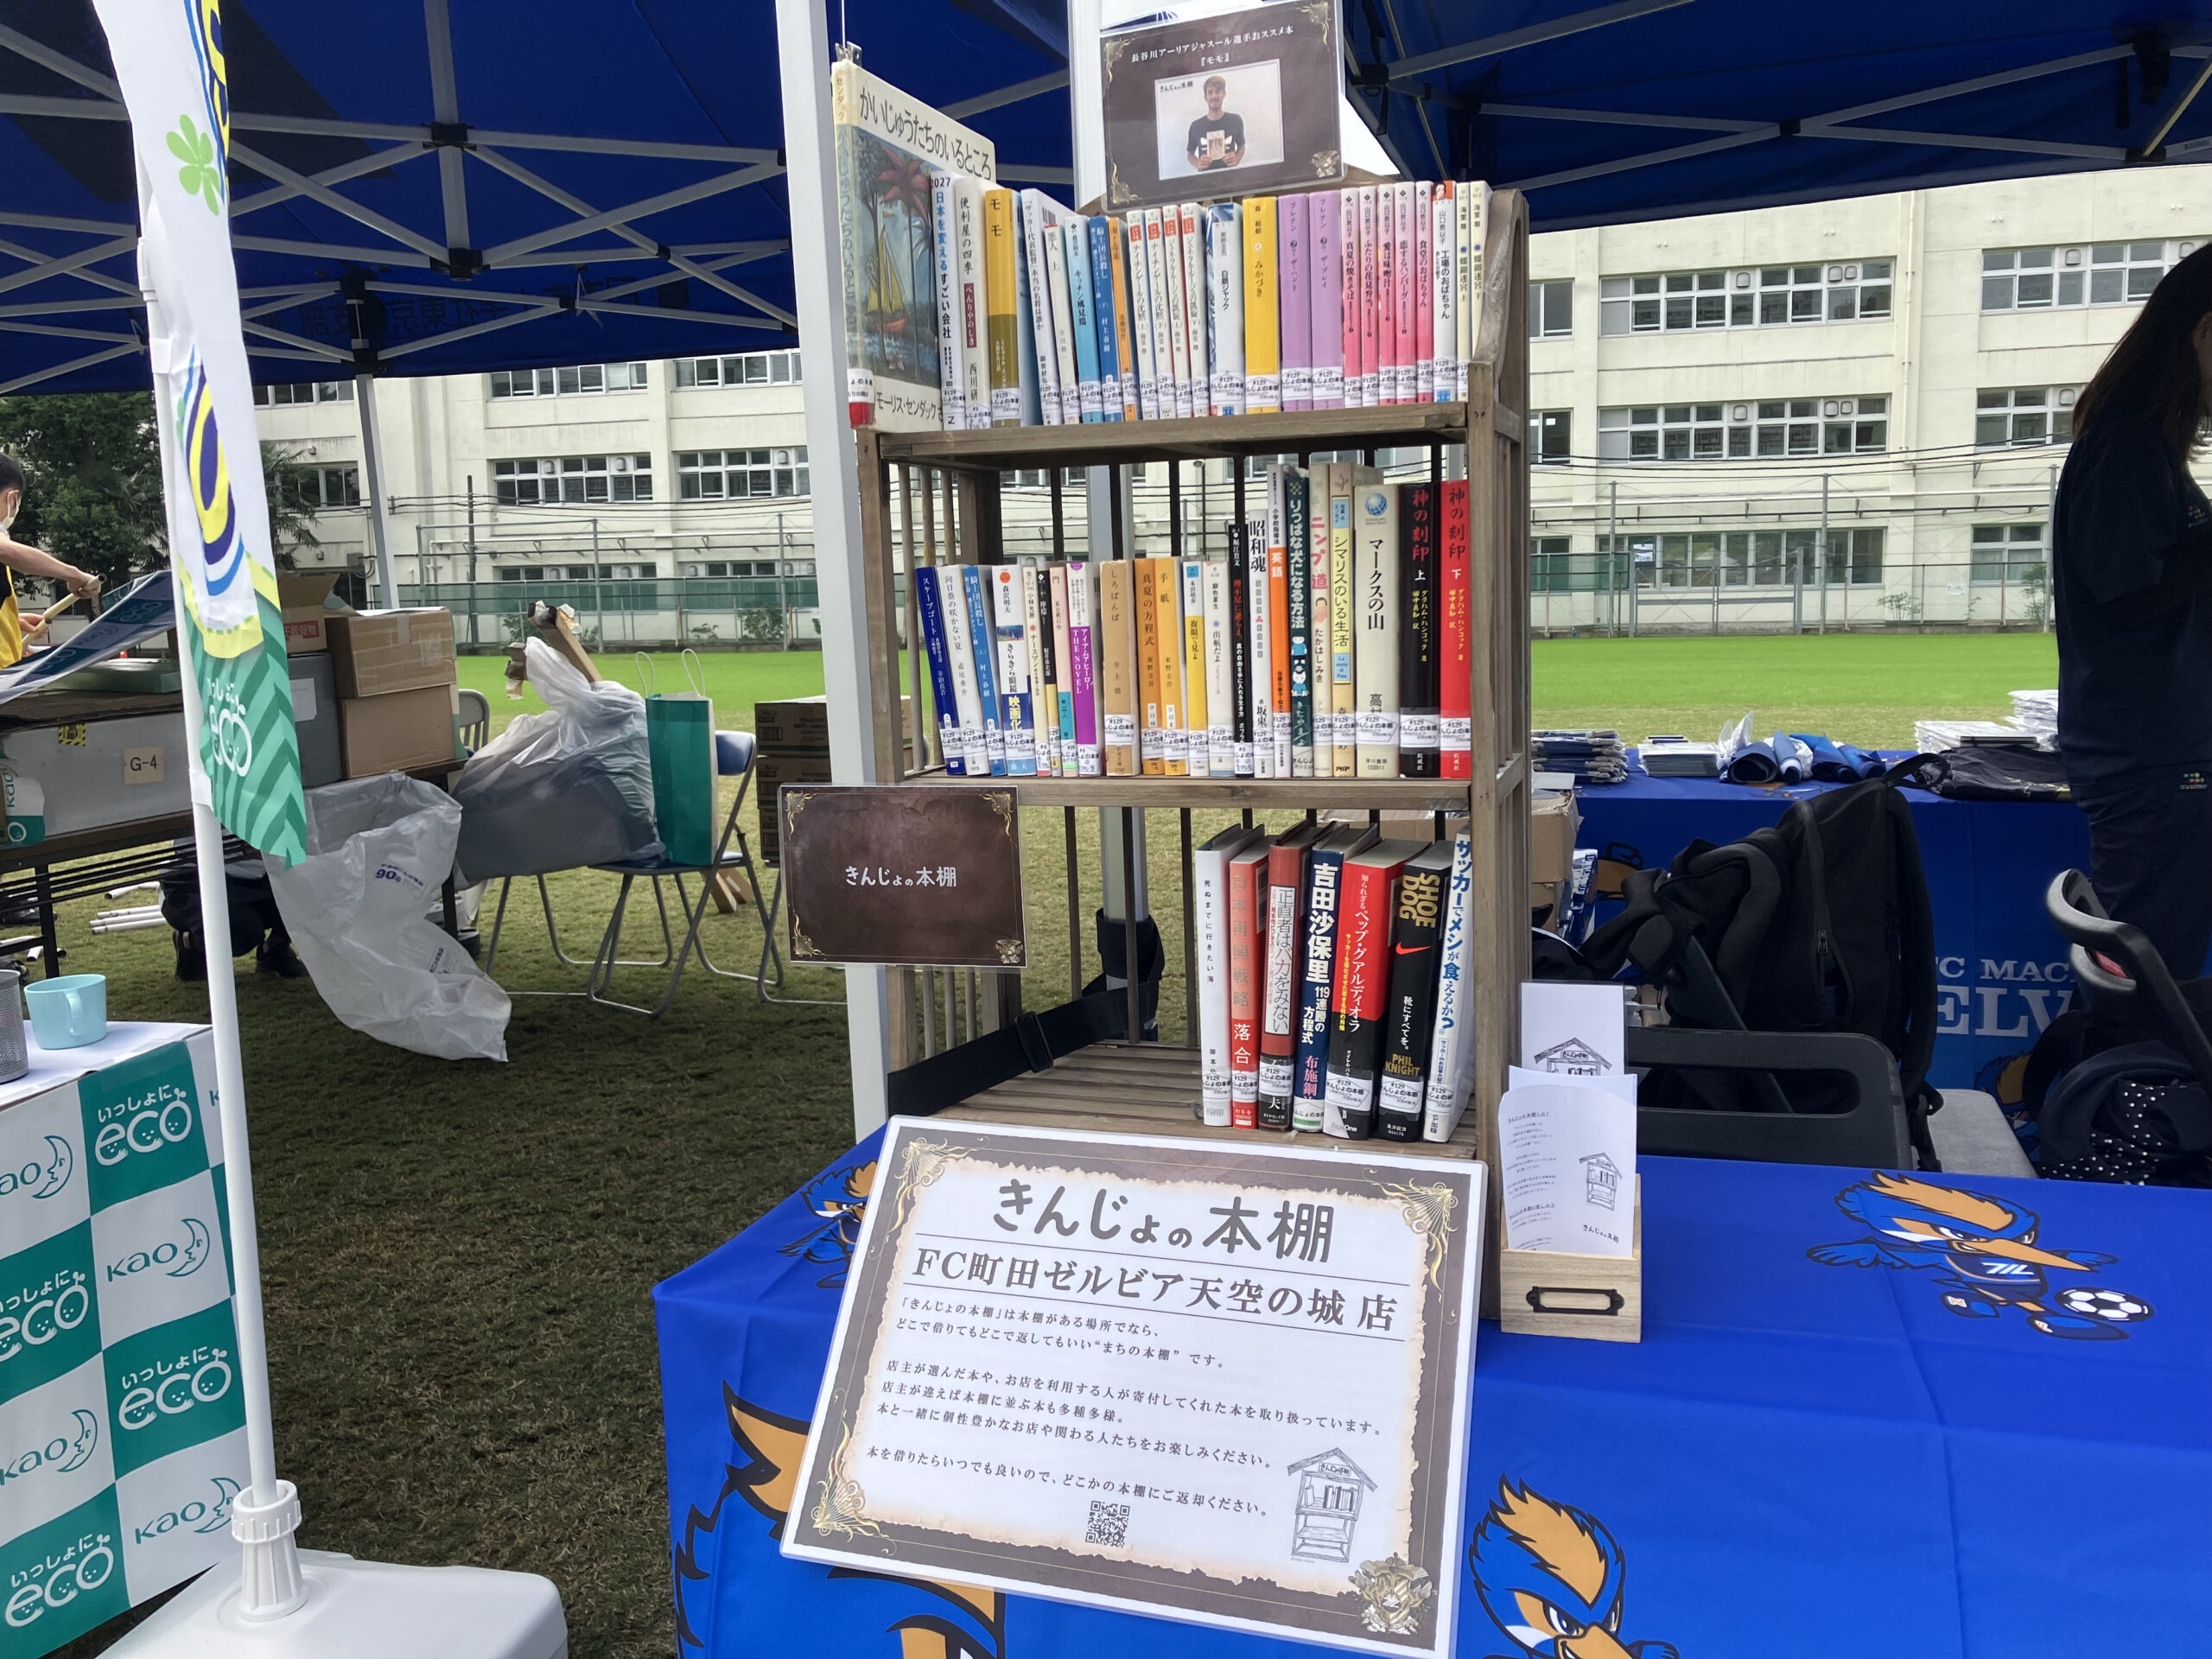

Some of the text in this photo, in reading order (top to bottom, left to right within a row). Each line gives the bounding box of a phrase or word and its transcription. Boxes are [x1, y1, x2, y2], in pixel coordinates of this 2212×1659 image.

[1131, 25, 1294, 63] 長谷川アーリアジャスール選手おススメ本
[1201, 53, 1230, 67] 『モモ』
[861, 87, 991, 180] かいじゅうたちのいるところ
[960, 197, 974, 275] 便利屋の四季
[990, 198, 1001, 237] モモ
[936, 192, 951, 339] 日本を変えるすごい会社
[1255, 261, 1264, 298] みかづき
[1440, 251, 1451, 320] 工場のおばちゃん
[1249, 520, 1268, 573] 昭和魂
[1310, 516, 1329, 590] ニンプ道
[1412, 488, 1430, 581] 神の刻印 上
[1448, 486, 1466, 580] 神の刻印 下
[1160, 573, 1170, 603] 手紙
[1272, 551, 1283, 578] 英語
[1289, 499, 1306, 629] りっぱな犬になる方法
[1367, 539, 1386, 631] マークスの山
[923, 577, 937, 636] スケープゴート
[944, 575, 963, 651] 向日葵の咲かない夏
[969, 576, 983, 627] 騎士団長殺し
[1002, 585, 1011, 613] 森沢明夫
[1110, 570, 1121, 621] しろばんば
[1142, 573, 1155, 646] 真夏の方程式
[1333, 536, 1351, 647] シマリスのいる生活
[1081, 628, 1094, 690] アイアムアヒーロー
[1190, 620, 1199, 660] 複眼で見よ
[1313, 628, 1324, 683] たかはしみき
[957, 663, 968, 696] 道尾秀介
[980, 664, 990, 697] 村上春樹
[1007, 643, 1018, 693] きらきら眼鏡
[1074, 655, 1084, 695] NOVEL
[1008, 695, 1023, 732] 映画化
[1256, 705, 1268, 728] 坂東
[130, 754, 158, 772] G-4
[844, 865, 957, 888] きんじょの本棚
[1399, 872, 1441, 930] SHOE DOG
[1204, 879, 1215, 983] 死ぬまでに行きたい海
[1231, 874, 1250, 1007] 日本再興戦略
[1306, 862, 1339, 985] 吉田沙保里
[1440, 838, 1472, 1031] サッカーでメシが食えるか?
[1274, 889, 1294, 1033] 正直者はバカをみない
[1348, 874, 1370, 1033] 知られざる ペップ・グアルディオラ
[1980, 959, 2075, 983] MAC
[1300, 1006, 1315, 1046] 方程式
[1313, 985, 1331, 1033] 119連勝の
[1401, 995, 1414, 1051] 靴にすべてを。
[1232, 1022, 1252, 1065] 落合
[1384, 1060, 1421, 1077] KNIGHT
[1391, 1053, 1414, 1067] PHIL
[1302, 1055, 1319, 1100] 布施鋼
[98, 1084, 172, 1123] いっしょに
[0, 1162, 41, 1196] ao
[993, 1178, 1335, 1263] きんじょの本棚
[106, 1242, 178, 1283] kao
[901, 1296, 1160, 1338] 「きんじょの本棚」は本棚がある場所でなら、
[121, 1345, 209, 1390] いっしょに
[880, 1380, 1124, 1424] 店主が違えば本棚に並ぶ本も多種多様。
[886, 1358, 1382, 1436] 店主が選んだ本や、お店を利用する人が寄付してくれた本を取り扱っています。
[875, 1402, 1272, 1469] 本と一緒に個性豊かなお店や関わる人たちをお楽しみください。
[0, 1437, 68, 1486] kao
[866, 1445, 1268, 1517] 本を借りたらいつでも良いので、どこかの本棚にご返却ください。
[134, 1501, 206, 1545] kao
[11, 1533, 93, 1589] いっしょに
